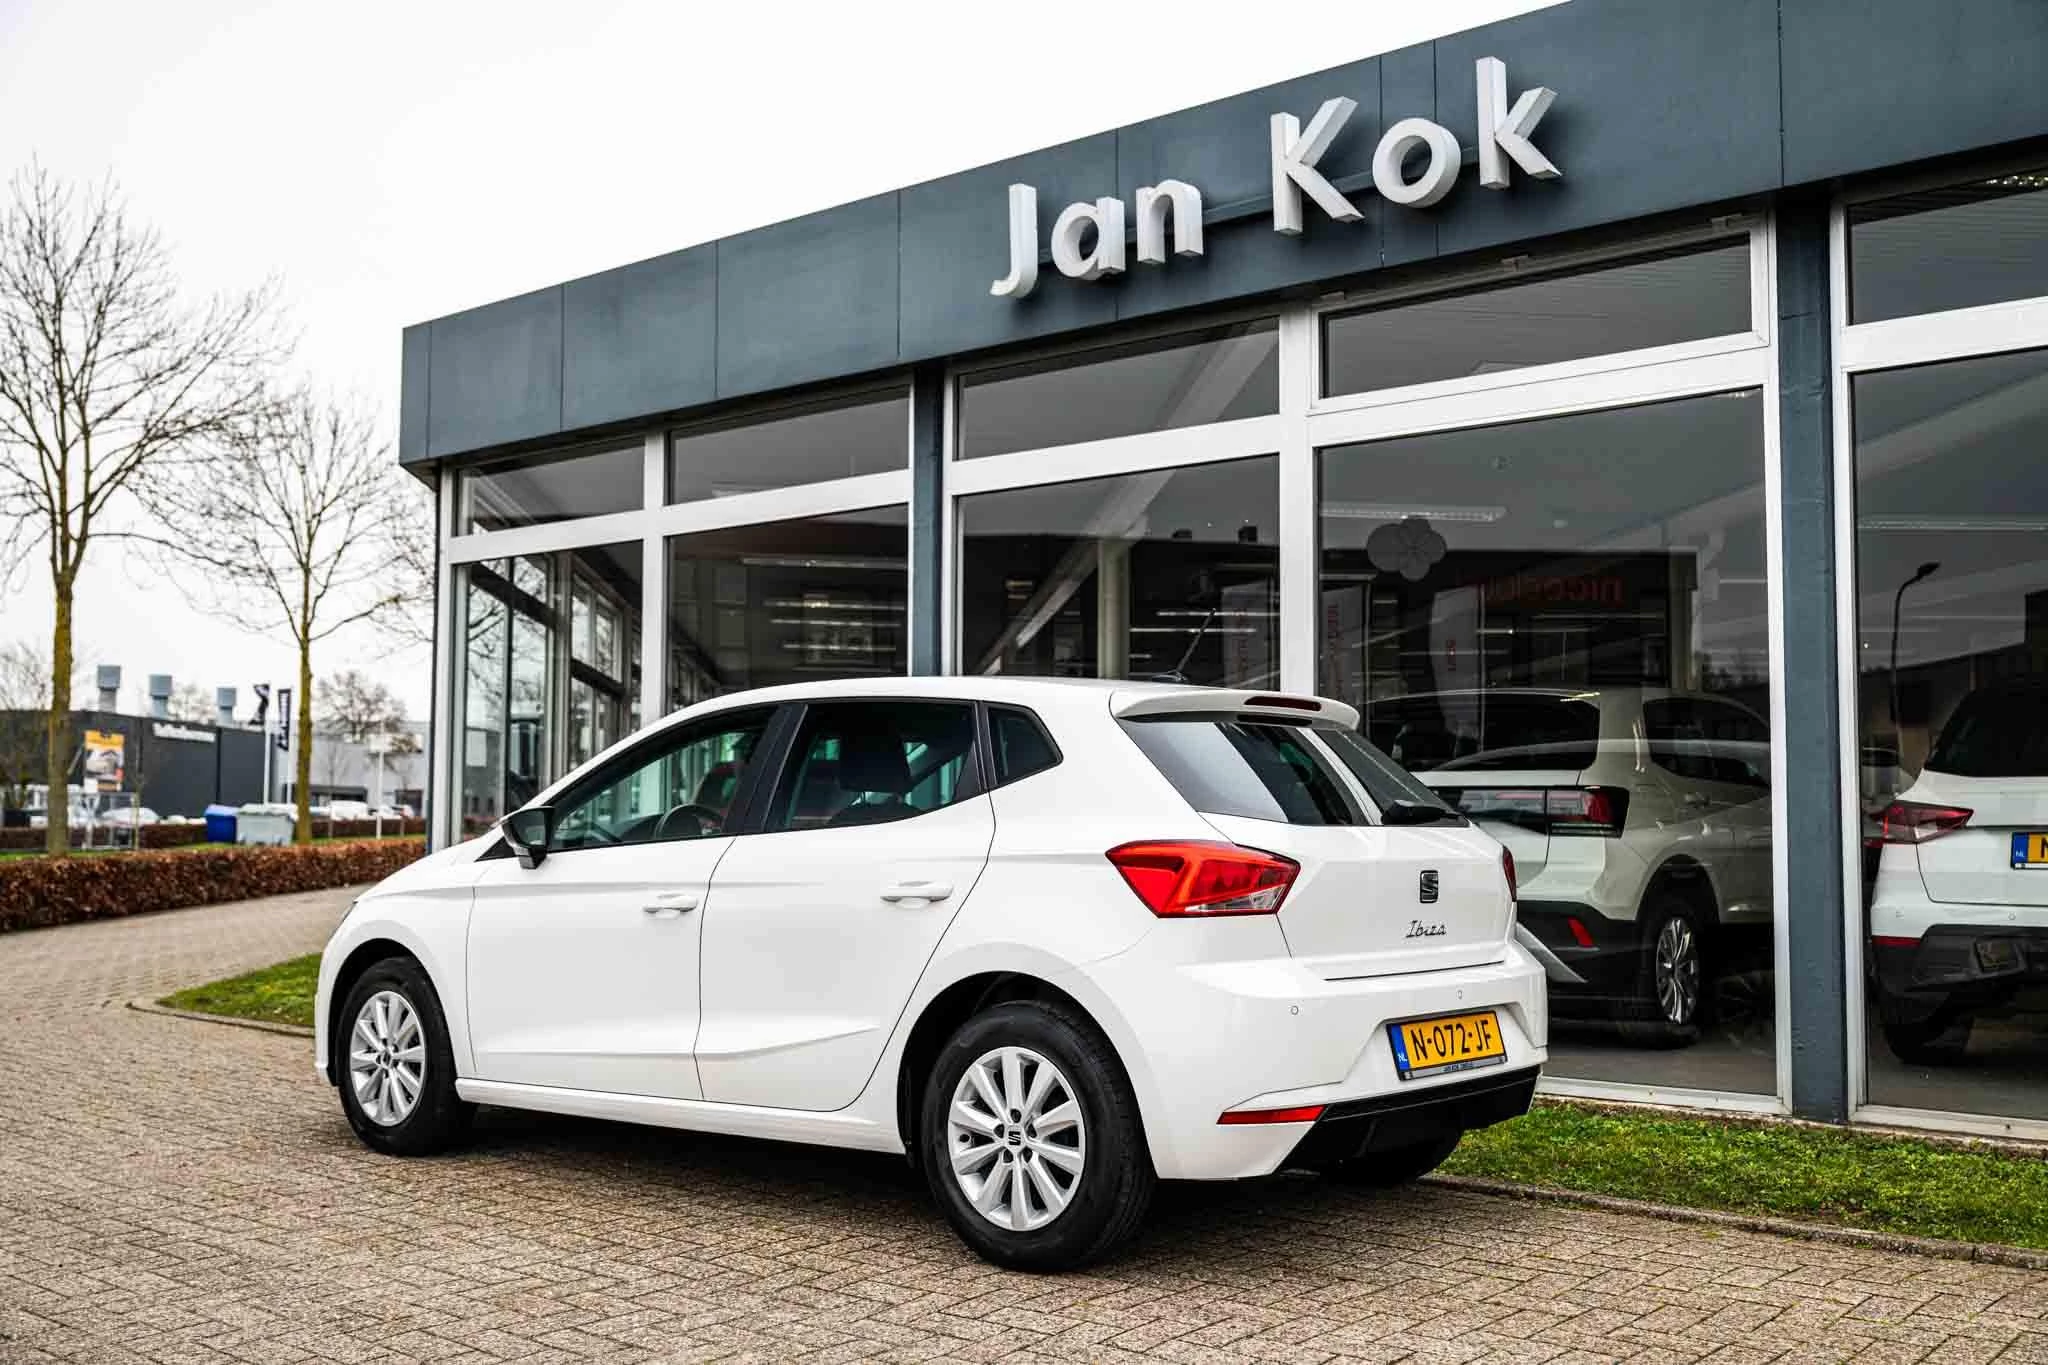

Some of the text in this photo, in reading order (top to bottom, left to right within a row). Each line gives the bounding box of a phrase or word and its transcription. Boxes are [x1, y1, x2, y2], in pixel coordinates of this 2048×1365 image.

[989, 56, 1564, 299] Jan Kok
[1405, 920, 1447, 938] Ibiza
[1410, 1019, 1492, 1061] N-072-JF
